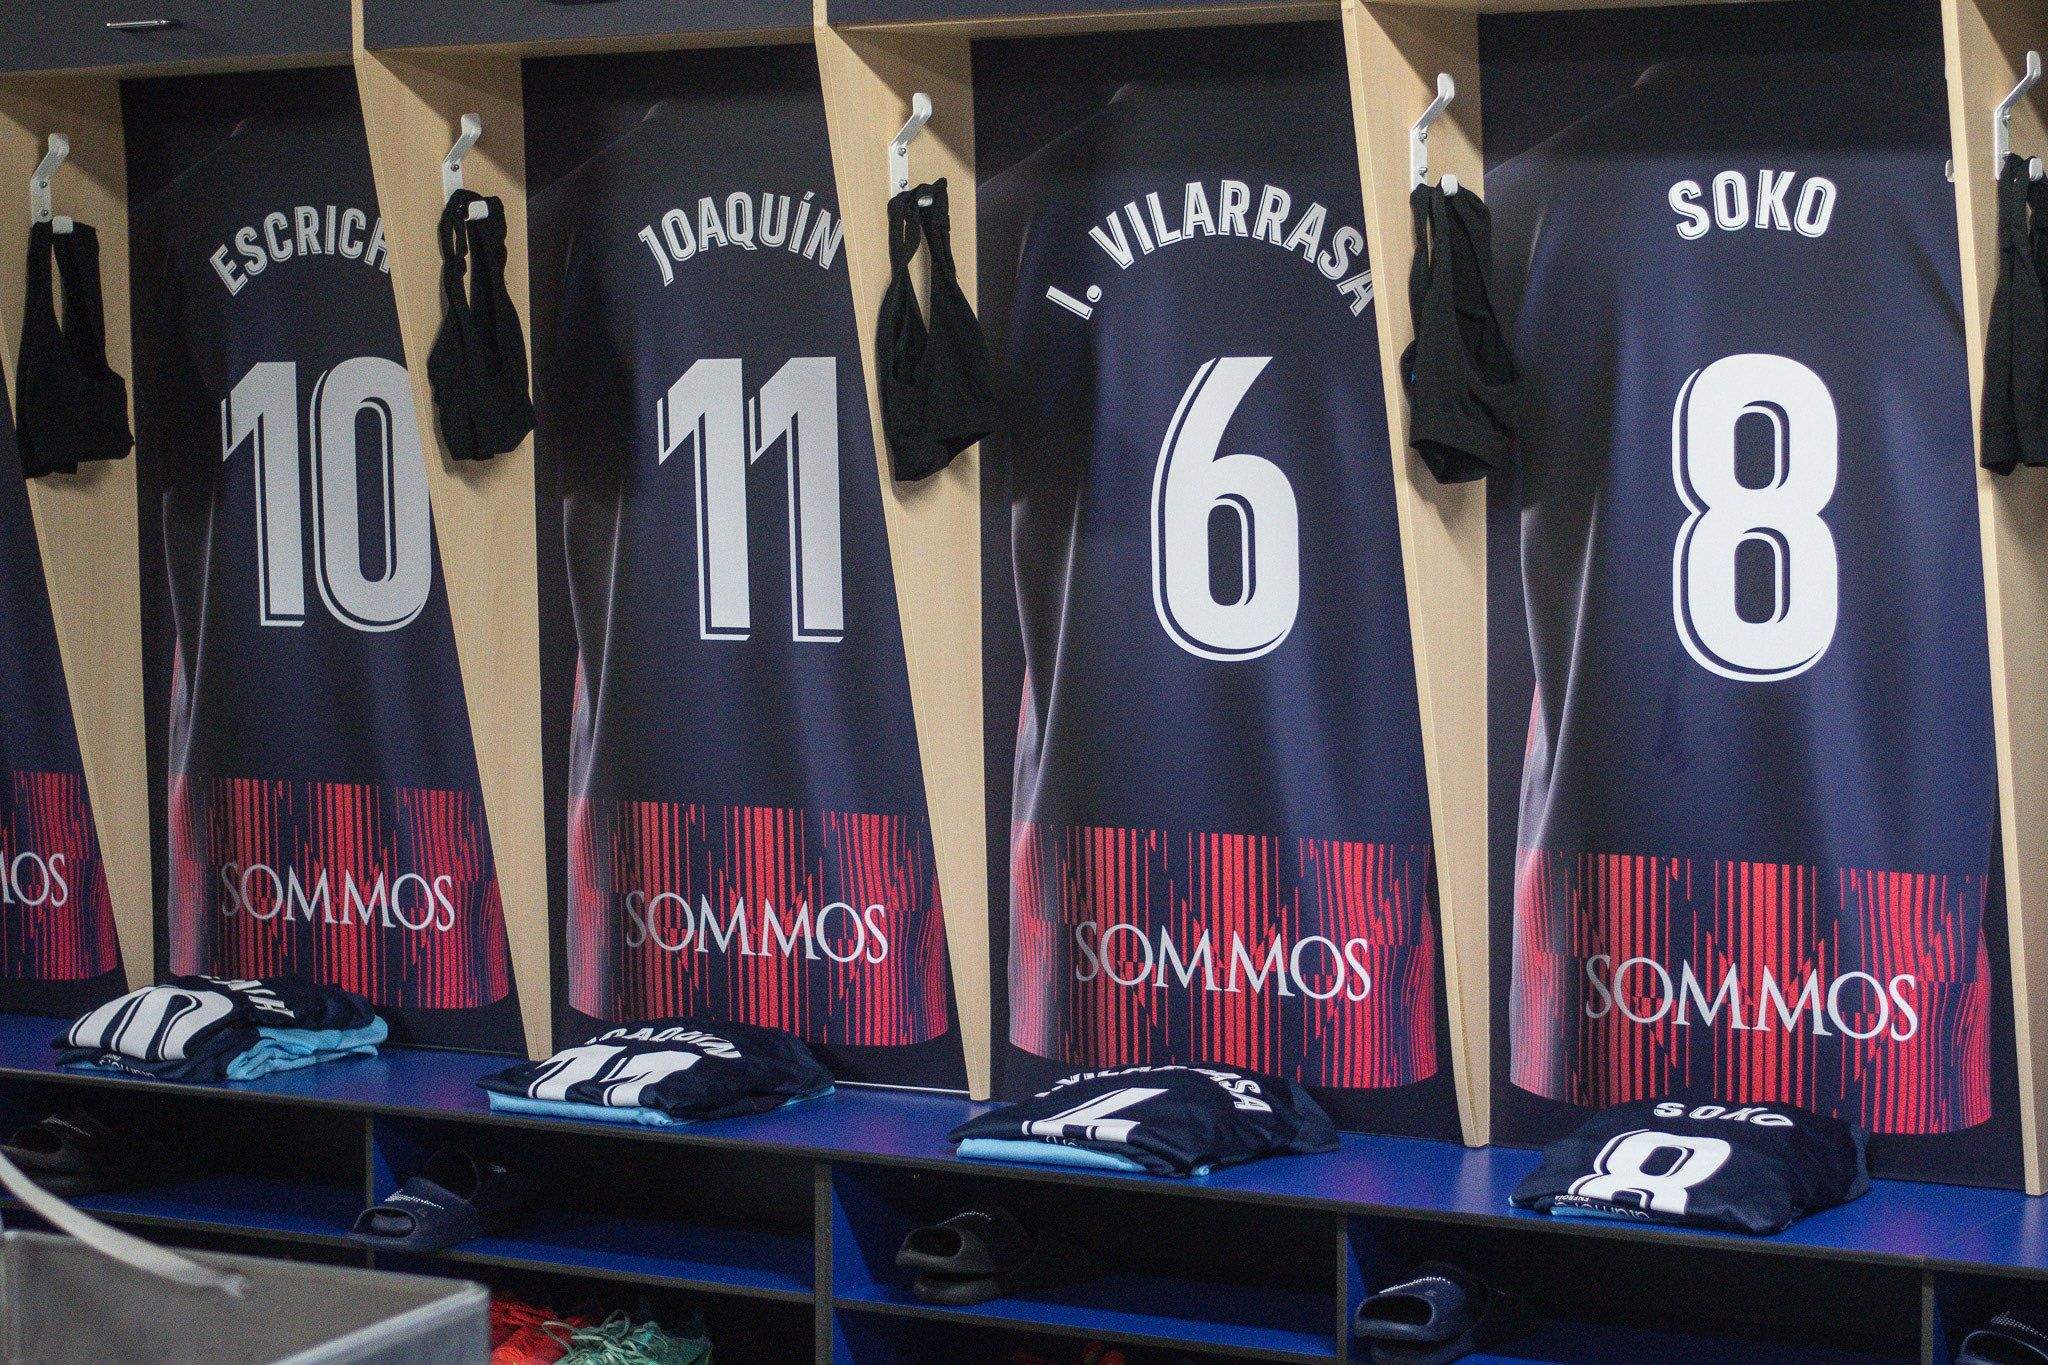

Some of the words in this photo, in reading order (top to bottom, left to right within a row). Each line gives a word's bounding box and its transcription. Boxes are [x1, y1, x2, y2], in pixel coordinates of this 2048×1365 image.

[638, 191, 844, 287] JOAQUÍN
[1668, 169, 1838, 240] SOKO
[1088, 180, 1376, 317] VILARRASA
[220, 356, 433, 633] 10
[657, 356, 845, 643] 11
[1151, 355, 1301, 662] 6
[1671, 353, 1838, 683] 8
[0, 851, 68, 907] OS
[221, 862, 456, 932] SOMMOS
[625, 890, 888, 964] SOMMOS
[1074, 921, 1371, 1001] SOMMOS
[69, 985, 233, 1060] 10
[1585, 954, 1918, 1042] SOMMOS
[1653, 1102, 1793, 1127] SOKO
[1568, 1129, 1731, 1214] 8
